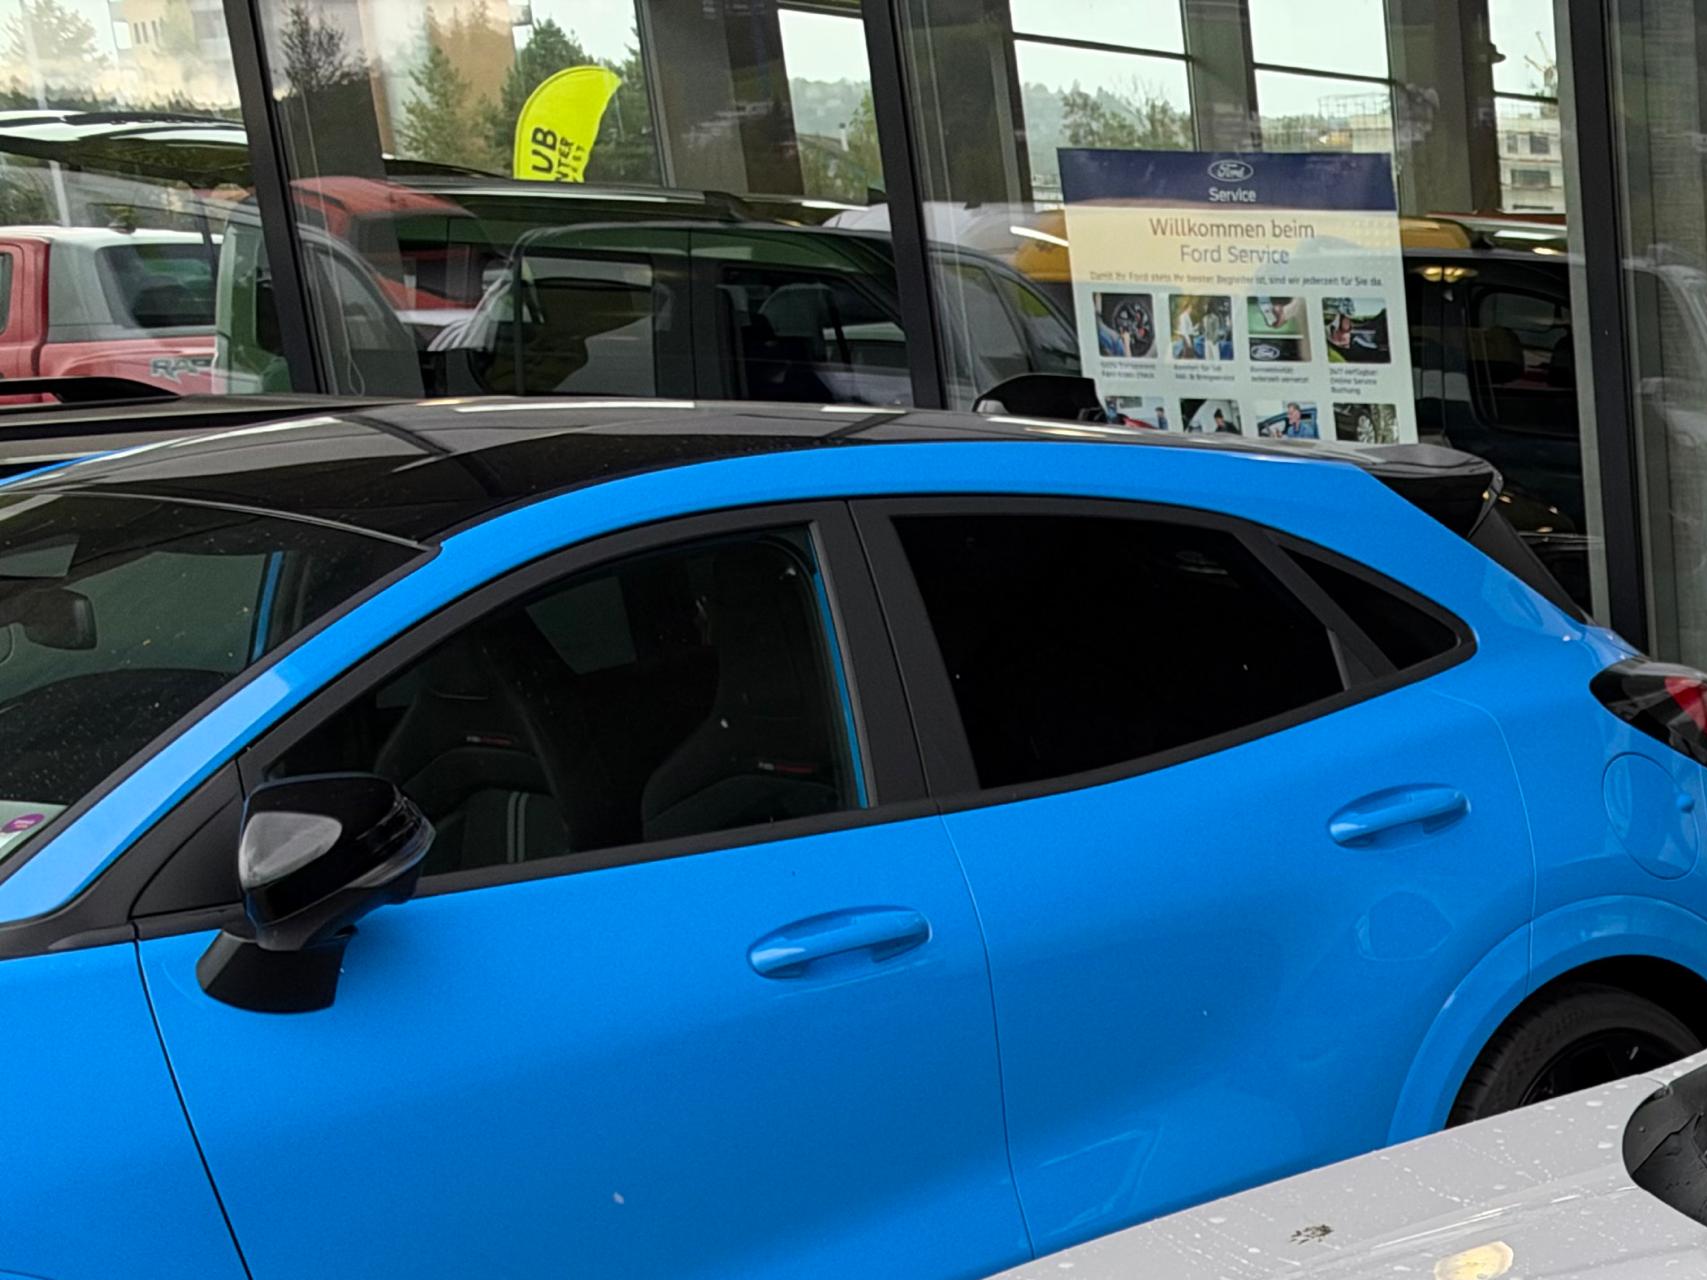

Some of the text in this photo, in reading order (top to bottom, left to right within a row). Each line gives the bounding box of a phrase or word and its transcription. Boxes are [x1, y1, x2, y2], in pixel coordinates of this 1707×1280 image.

[531, 127, 558, 174] UB
[1208, 187, 1256, 204] Service
[1149, 217, 1315, 240] Willkommen beim
[1180, 245, 1290, 265] Ford Service
[1269, 276, 1286, 285] sind
[1301, 276, 1339, 287] jederzeit
[1341, 277, 1353, 286] für
[1355, 277, 1368, 286] Sie
